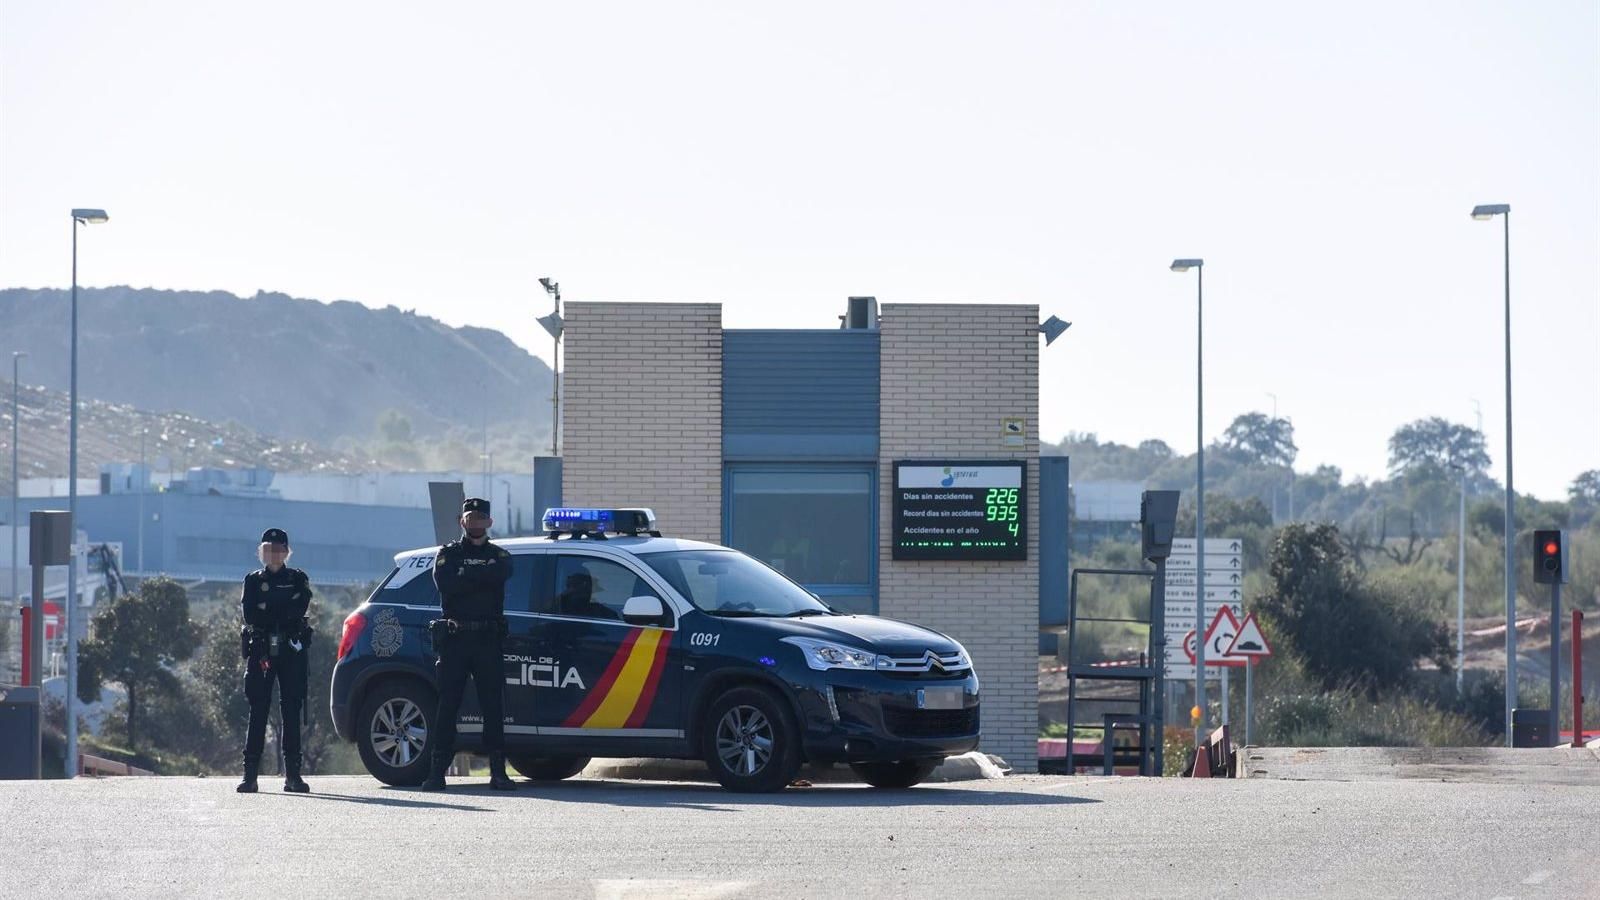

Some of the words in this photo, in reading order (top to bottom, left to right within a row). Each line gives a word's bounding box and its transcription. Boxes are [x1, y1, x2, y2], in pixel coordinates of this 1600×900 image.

[986, 489, 1018, 504] 226
[987, 506, 1018, 521] 935
[1008, 523, 1019, 537] 4
[539, 656, 553, 664] DE
